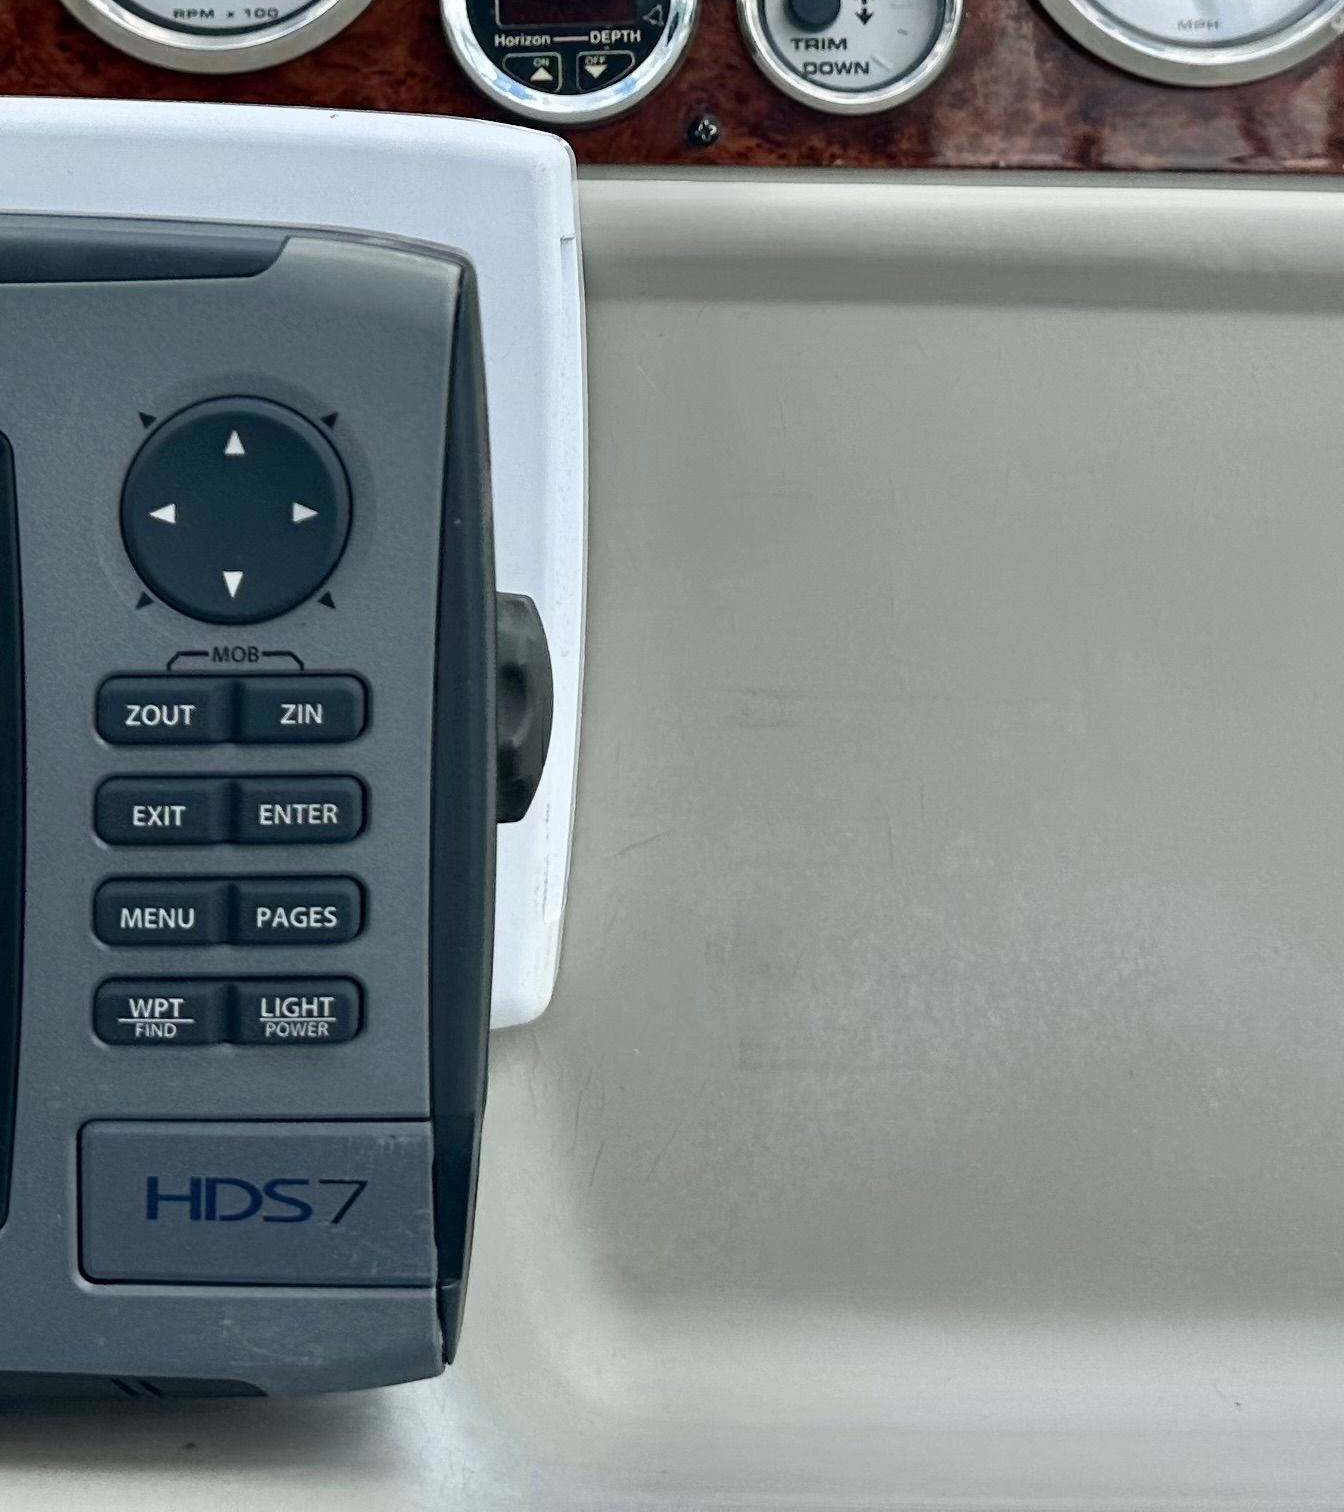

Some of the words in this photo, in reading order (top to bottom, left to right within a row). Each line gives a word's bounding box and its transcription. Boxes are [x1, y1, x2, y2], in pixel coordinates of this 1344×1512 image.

[173, 8, 215, 19] RPM
[244, 8, 280, 19] 100
[1177, 20, 1221, 31] MPH
[494, 34, 551, 47] Horizon
[590, 30, 641, 44] DEPTH
[790, 38, 847, 51] TRIM
[533, 56, 550, 67] ON
[584, 55, 607, 66] OFF
[802, 62, 870, 76] DOWN
[211, 646, 260, 663] MOB
[125, 704, 197, 726] ZOUT
[280, 703, 324, 725] ZIN
[132, 805, 186, 827] EXIT
[259, 803, 338, 825] ENTER
[120, 908, 195, 929] MENU
[256, 906, 338, 928] PAGES
[128, 998, 184, 1018] WPT
[260, 996, 335, 1018] LIGHT
[135, 1023, 177, 1038] FIND
[265, 1022, 330, 1038] POWER
